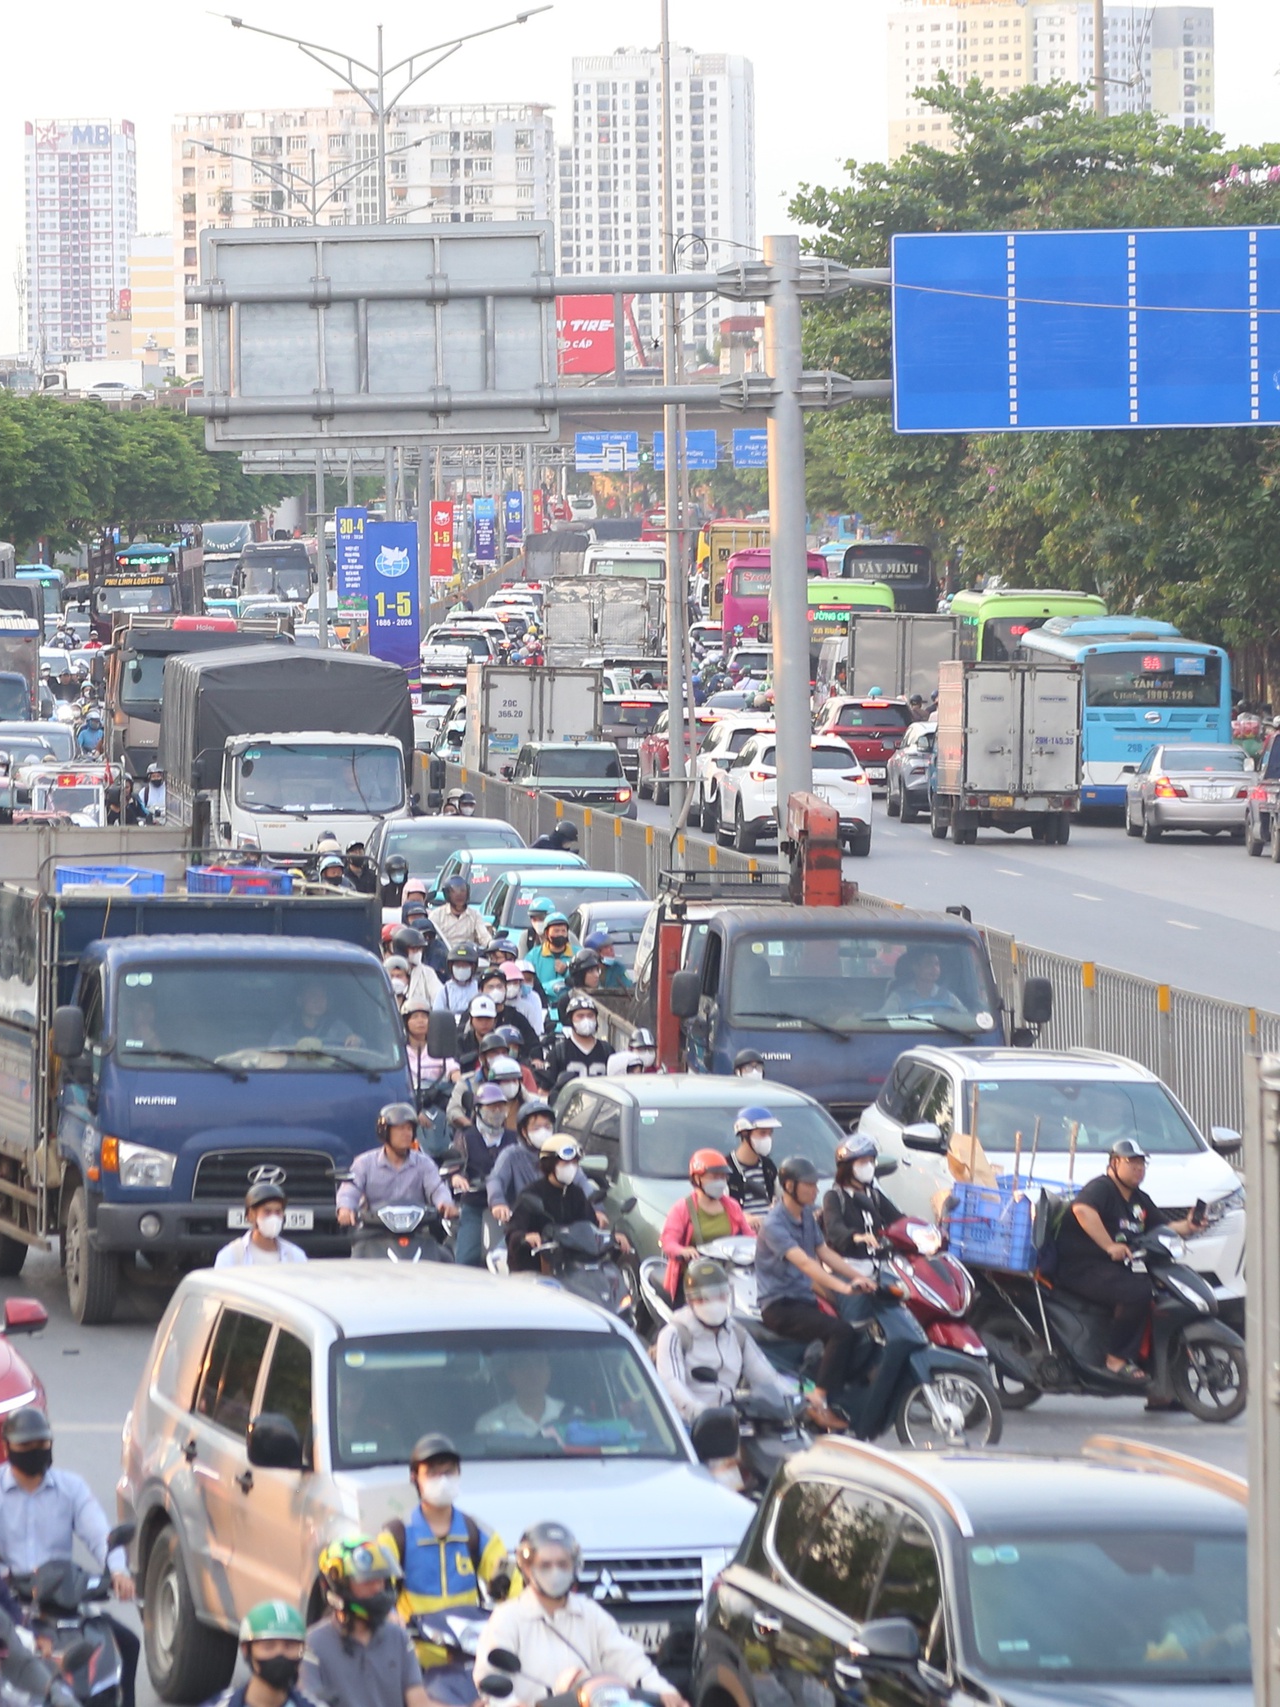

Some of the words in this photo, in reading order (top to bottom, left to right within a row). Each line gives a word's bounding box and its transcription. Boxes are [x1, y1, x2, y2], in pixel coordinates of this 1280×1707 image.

[73, 125, 110, 145] MB
[434, 531, 450, 543] 1-5
[375, 592, 411, 617] 1-5
[135, 1096, 177, 1105] HYUNDAI
